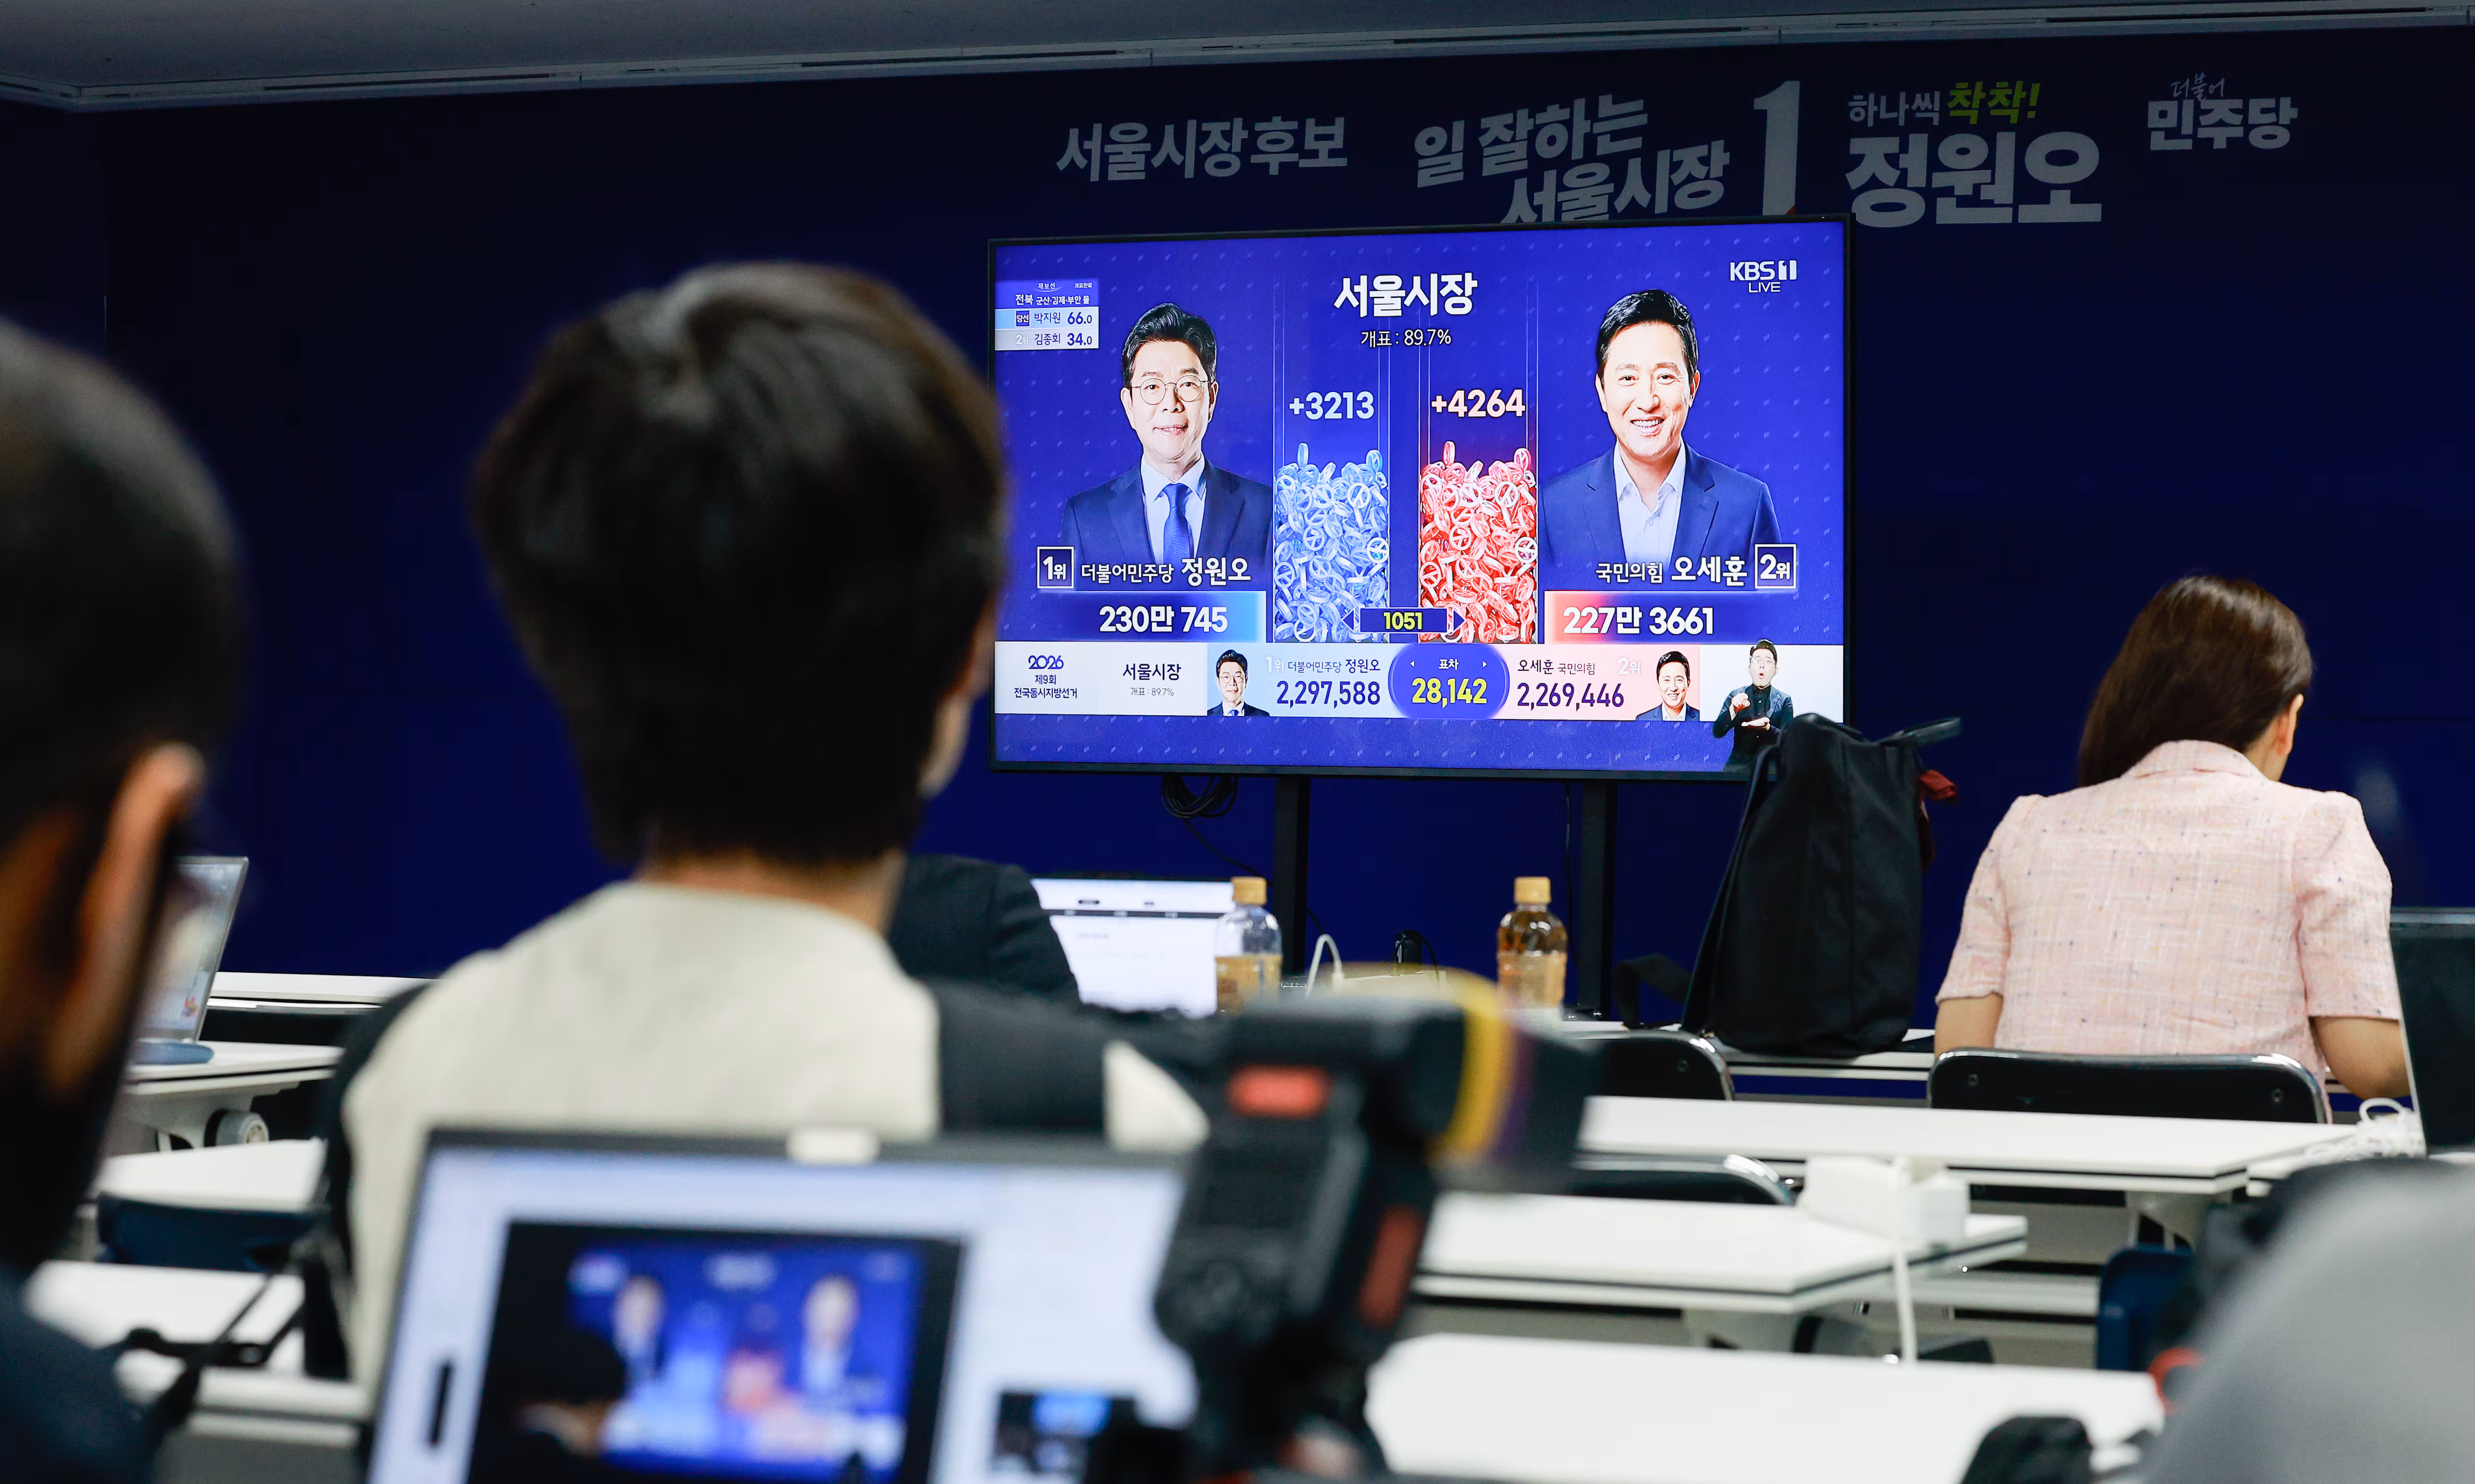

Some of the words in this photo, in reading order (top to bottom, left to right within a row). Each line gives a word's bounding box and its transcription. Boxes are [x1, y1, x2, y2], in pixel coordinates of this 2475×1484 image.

[2171, 72, 2225, 101] 더불어
[1848, 91, 1940, 127] 하나씩
[1947, 81, 2041, 125] 착착!
[2147, 97, 2298, 150] 민주당
[1414, 120, 1464, 188] 일
[1478, 94, 1648, 176] 잘하는
[1754, 80, 1800, 216] 1
[1500, 140, 1730, 223] 서울시장
[1845, 131, 2102, 228] 정원오
[1015, 294, 1034, 305] 전북
[1334, 272, 1478, 318] 서울시장
[1749, 282, 1781, 293] LIVE
[1016, 314, 1030, 323] 당선
[1034, 312, 1061, 325] 박지원
[1067, 311, 1092, 325] 66.0
[1015, 334, 1029, 345] 2위
[1034, 333, 1061, 346] 김종회
[1067, 333, 1092, 346] 34.0
[1361, 330, 1392, 348] 개표
[1404, 329, 1451, 346] 89.7%
[1289, 392, 1375, 420] +3213
[1432, 389, 1526, 418] +4264
[1043, 556, 1067, 581] 1위
[1081, 563, 1175, 584] 더불어민주당
[1181, 556, 1251, 587] 정원오
[1595, 562, 1663, 584] 국민의힘
[1671, 556, 1748, 587] 오세훈
[1759, 554, 1790, 580] 2위
[1099, 605, 1174, 633] 230만
[1181, 606, 1228, 633] 745
[1383, 612, 1423, 630] 1051
[1563, 606, 1642, 635] 227만
[1649, 607, 1714, 635] 3661
[1028, 655, 1064, 669] 2026
[1123, 663, 1182, 681] 서울시장
[1266, 656, 1284, 672] 1위
[1288, 661, 1342, 673] 더불어민주당
[1345, 659, 1381, 673] 정원오
[1438, 658, 1459, 671] 표차
[1518, 659, 1554, 675] 오세훈
[1558, 663, 1595, 675] 국민의힘
[1617, 657, 1641, 675] 2위
[1014, 688, 1078, 698] 전국동시지방선거
[1035, 674, 1056, 685] 제9회
[1131, 687, 1145, 696] 개표
[1151, 688, 1175, 696] 89.7%
[1412, 678, 1487, 708] 28,142
[1277, 681, 1380, 709] 2,297,588
[1517, 683, 1624, 711] 2,269,446
